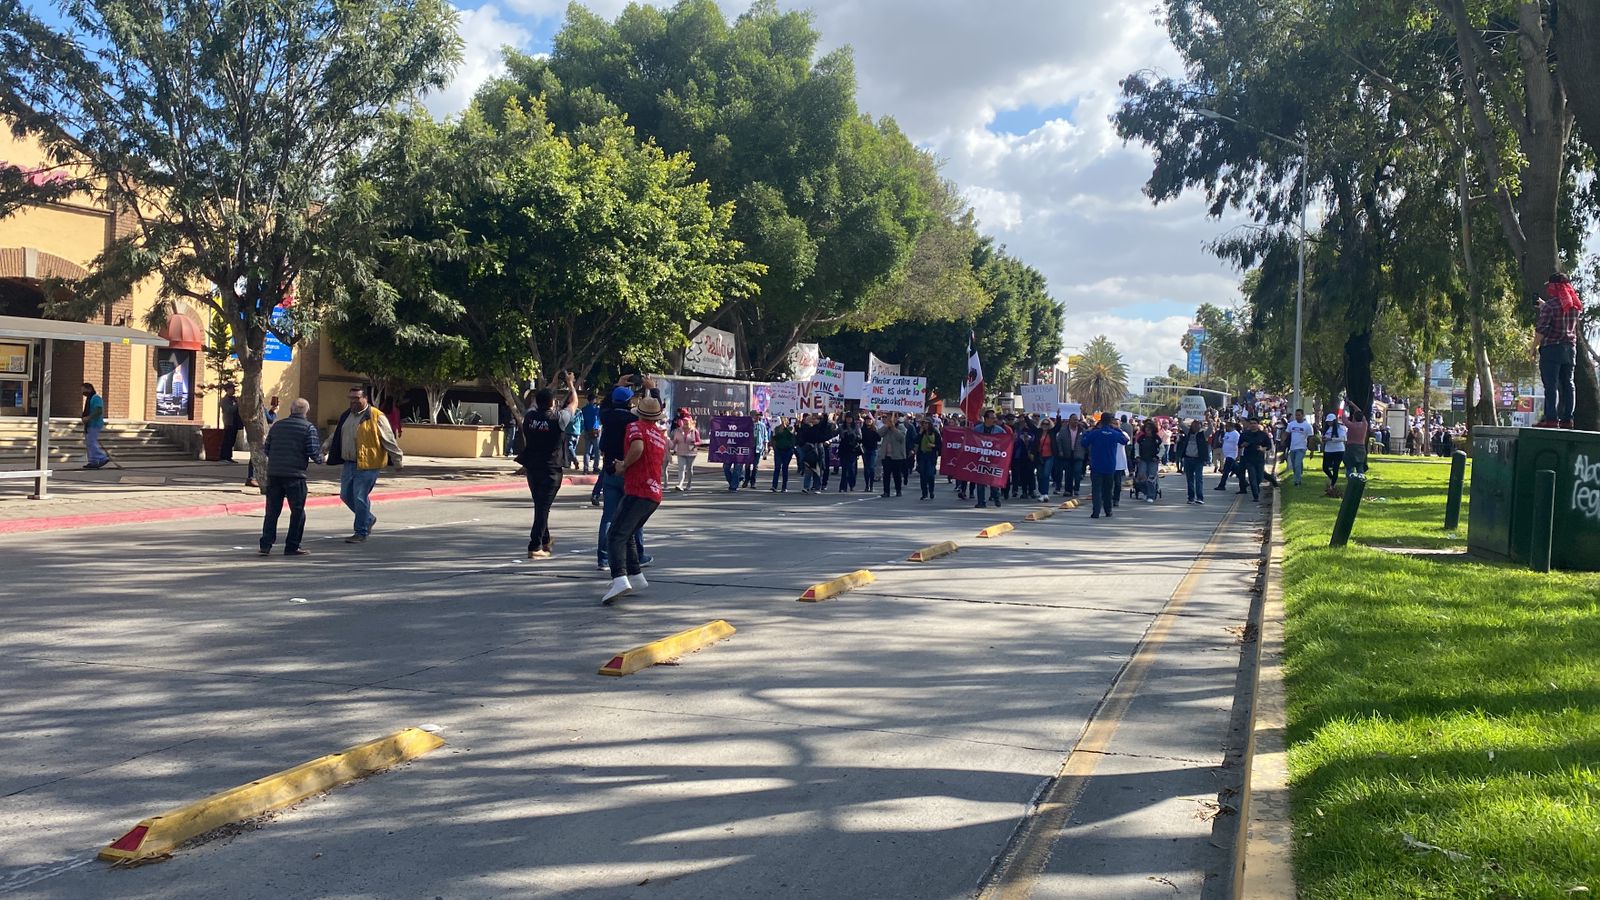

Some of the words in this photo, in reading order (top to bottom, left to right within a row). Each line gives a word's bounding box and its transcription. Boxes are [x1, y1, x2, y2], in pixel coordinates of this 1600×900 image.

[872, 386, 884, 394] INE
[1032, 402, 1052, 412] INE
[981, 440, 993, 448] YO
[727, 446, 750, 455] INE
[964, 446, 1007, 457] DEFIENDO
[978, 456, 991, 464] AL
[976, 464, 1004, 478] INE
